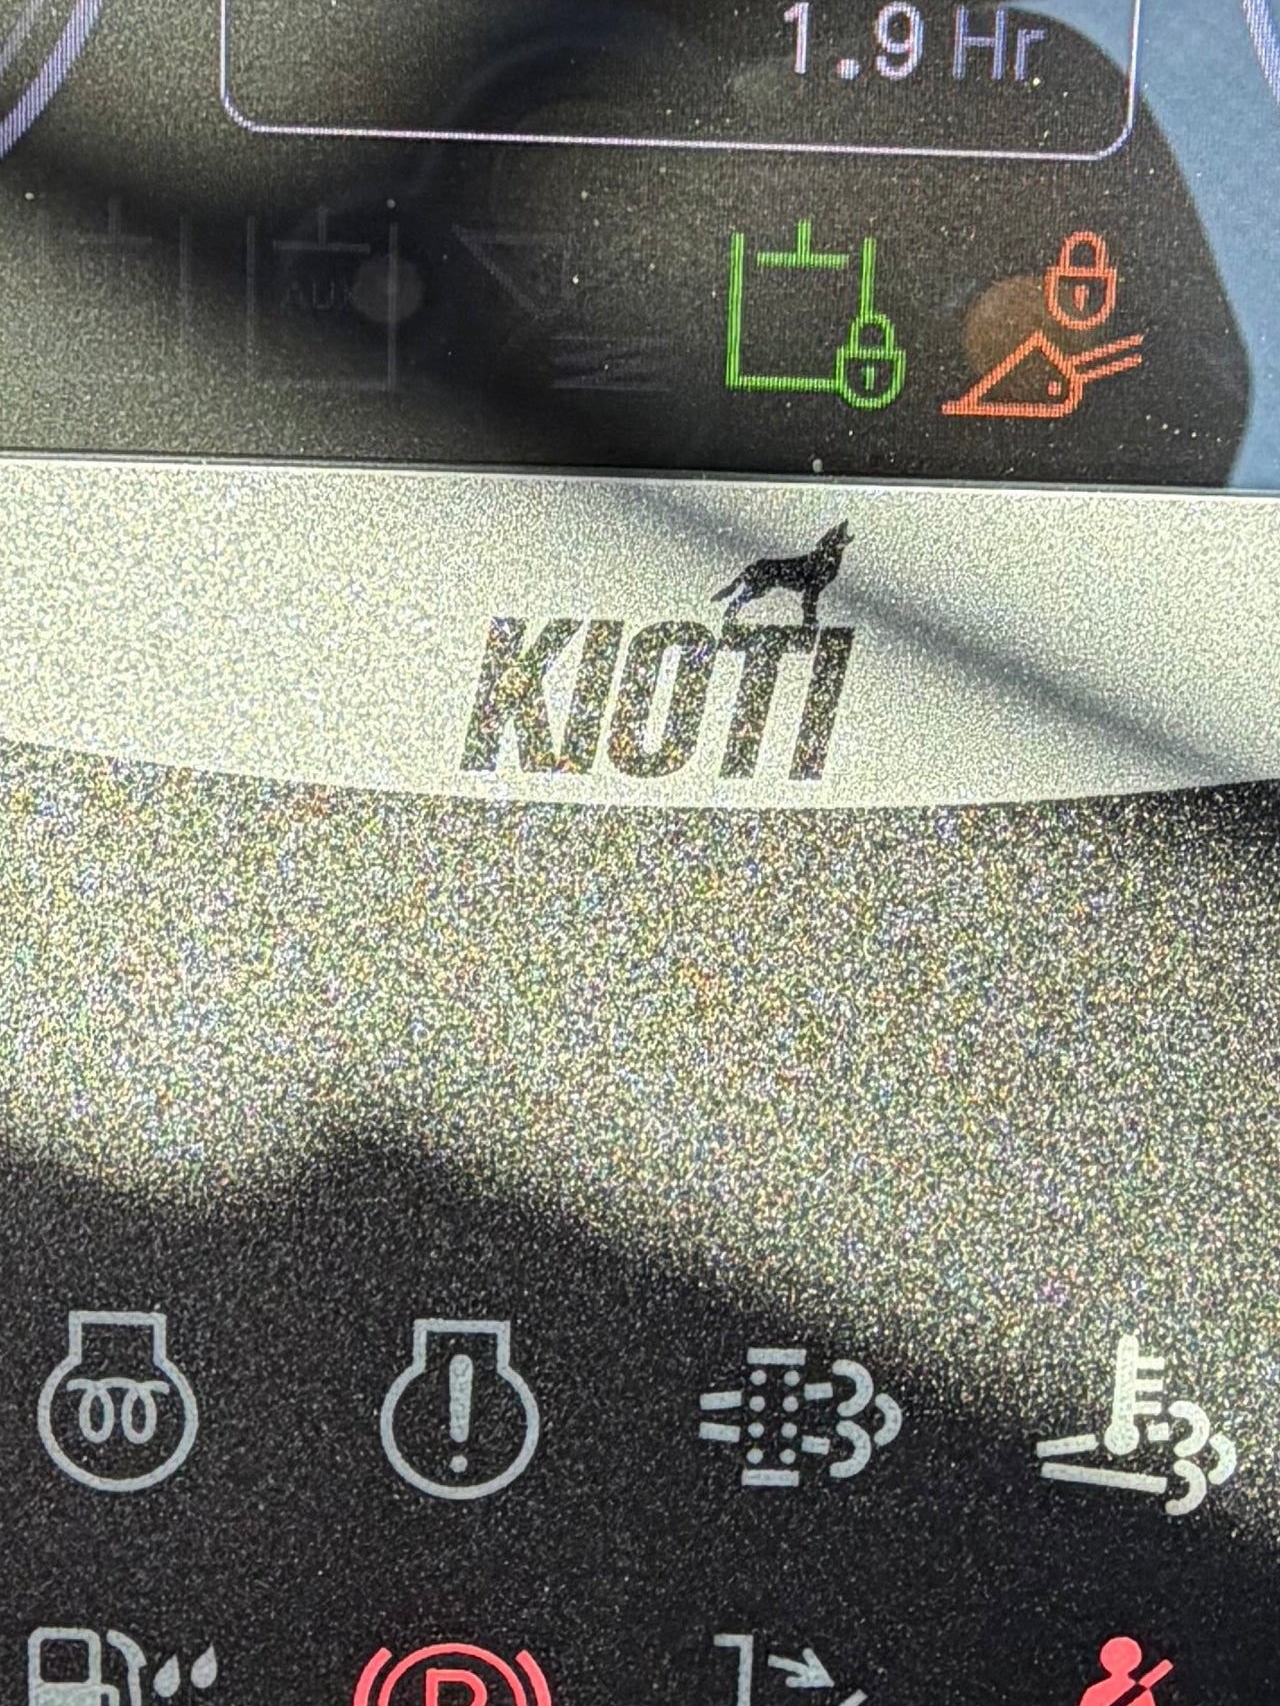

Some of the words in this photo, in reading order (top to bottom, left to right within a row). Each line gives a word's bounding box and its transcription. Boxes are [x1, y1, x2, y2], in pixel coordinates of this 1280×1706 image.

[782, 1, 923, 81] 1.9
[951, 5, 1048, 81] Hr
[458, 615, 856, 781] KIOTI
